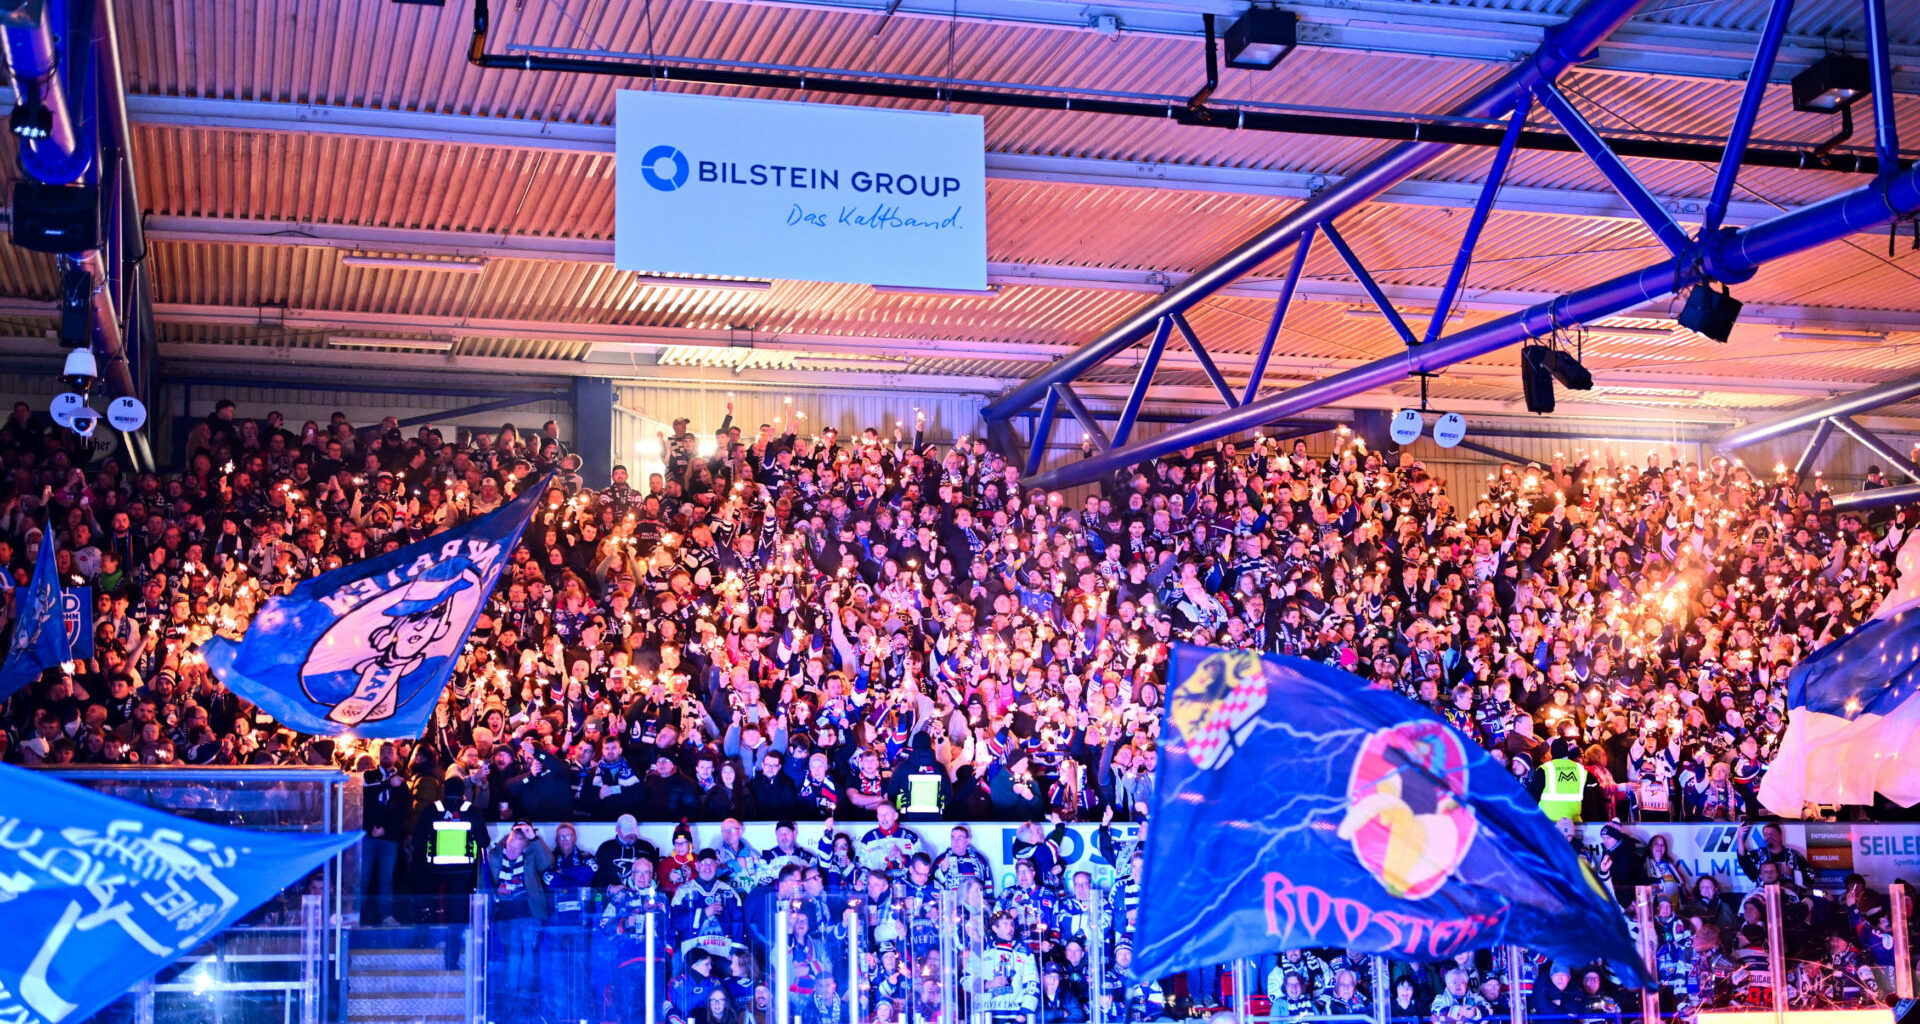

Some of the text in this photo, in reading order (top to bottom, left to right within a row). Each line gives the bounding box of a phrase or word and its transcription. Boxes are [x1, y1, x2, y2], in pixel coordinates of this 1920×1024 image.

[699, 161, 961, 198] BILSTEIN GROUP
[786, 203, 963, 230] Das Kaltband.
[65, 395, 76, 404] 15
[122, 399, 134, 408] 16
[1406, 412, 1415, 420] 13
[1449, 415, 1458, 423] 14
